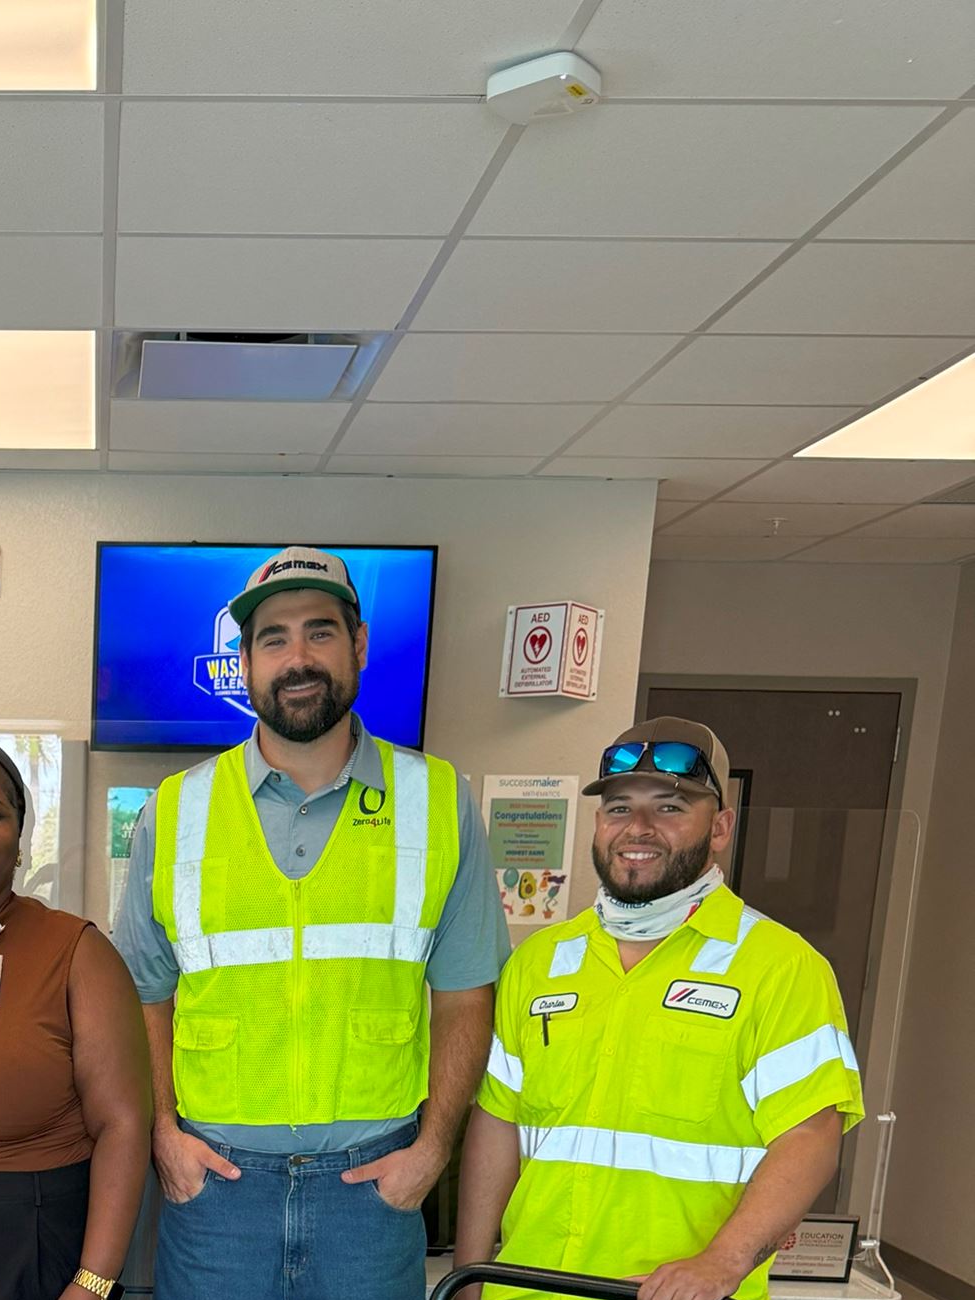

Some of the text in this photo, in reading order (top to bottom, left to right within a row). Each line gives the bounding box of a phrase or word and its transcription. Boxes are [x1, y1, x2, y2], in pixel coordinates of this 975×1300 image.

[530, 612, 551, 624] AED
[578, 614, 589, 625] AED
[213, 678, 247, 690] ELEM
[498, 777, 561, 787] successmaker
[494, 811, 562, 822] Congratulations
[800, 1232, 844, 1240] EDUCATION
